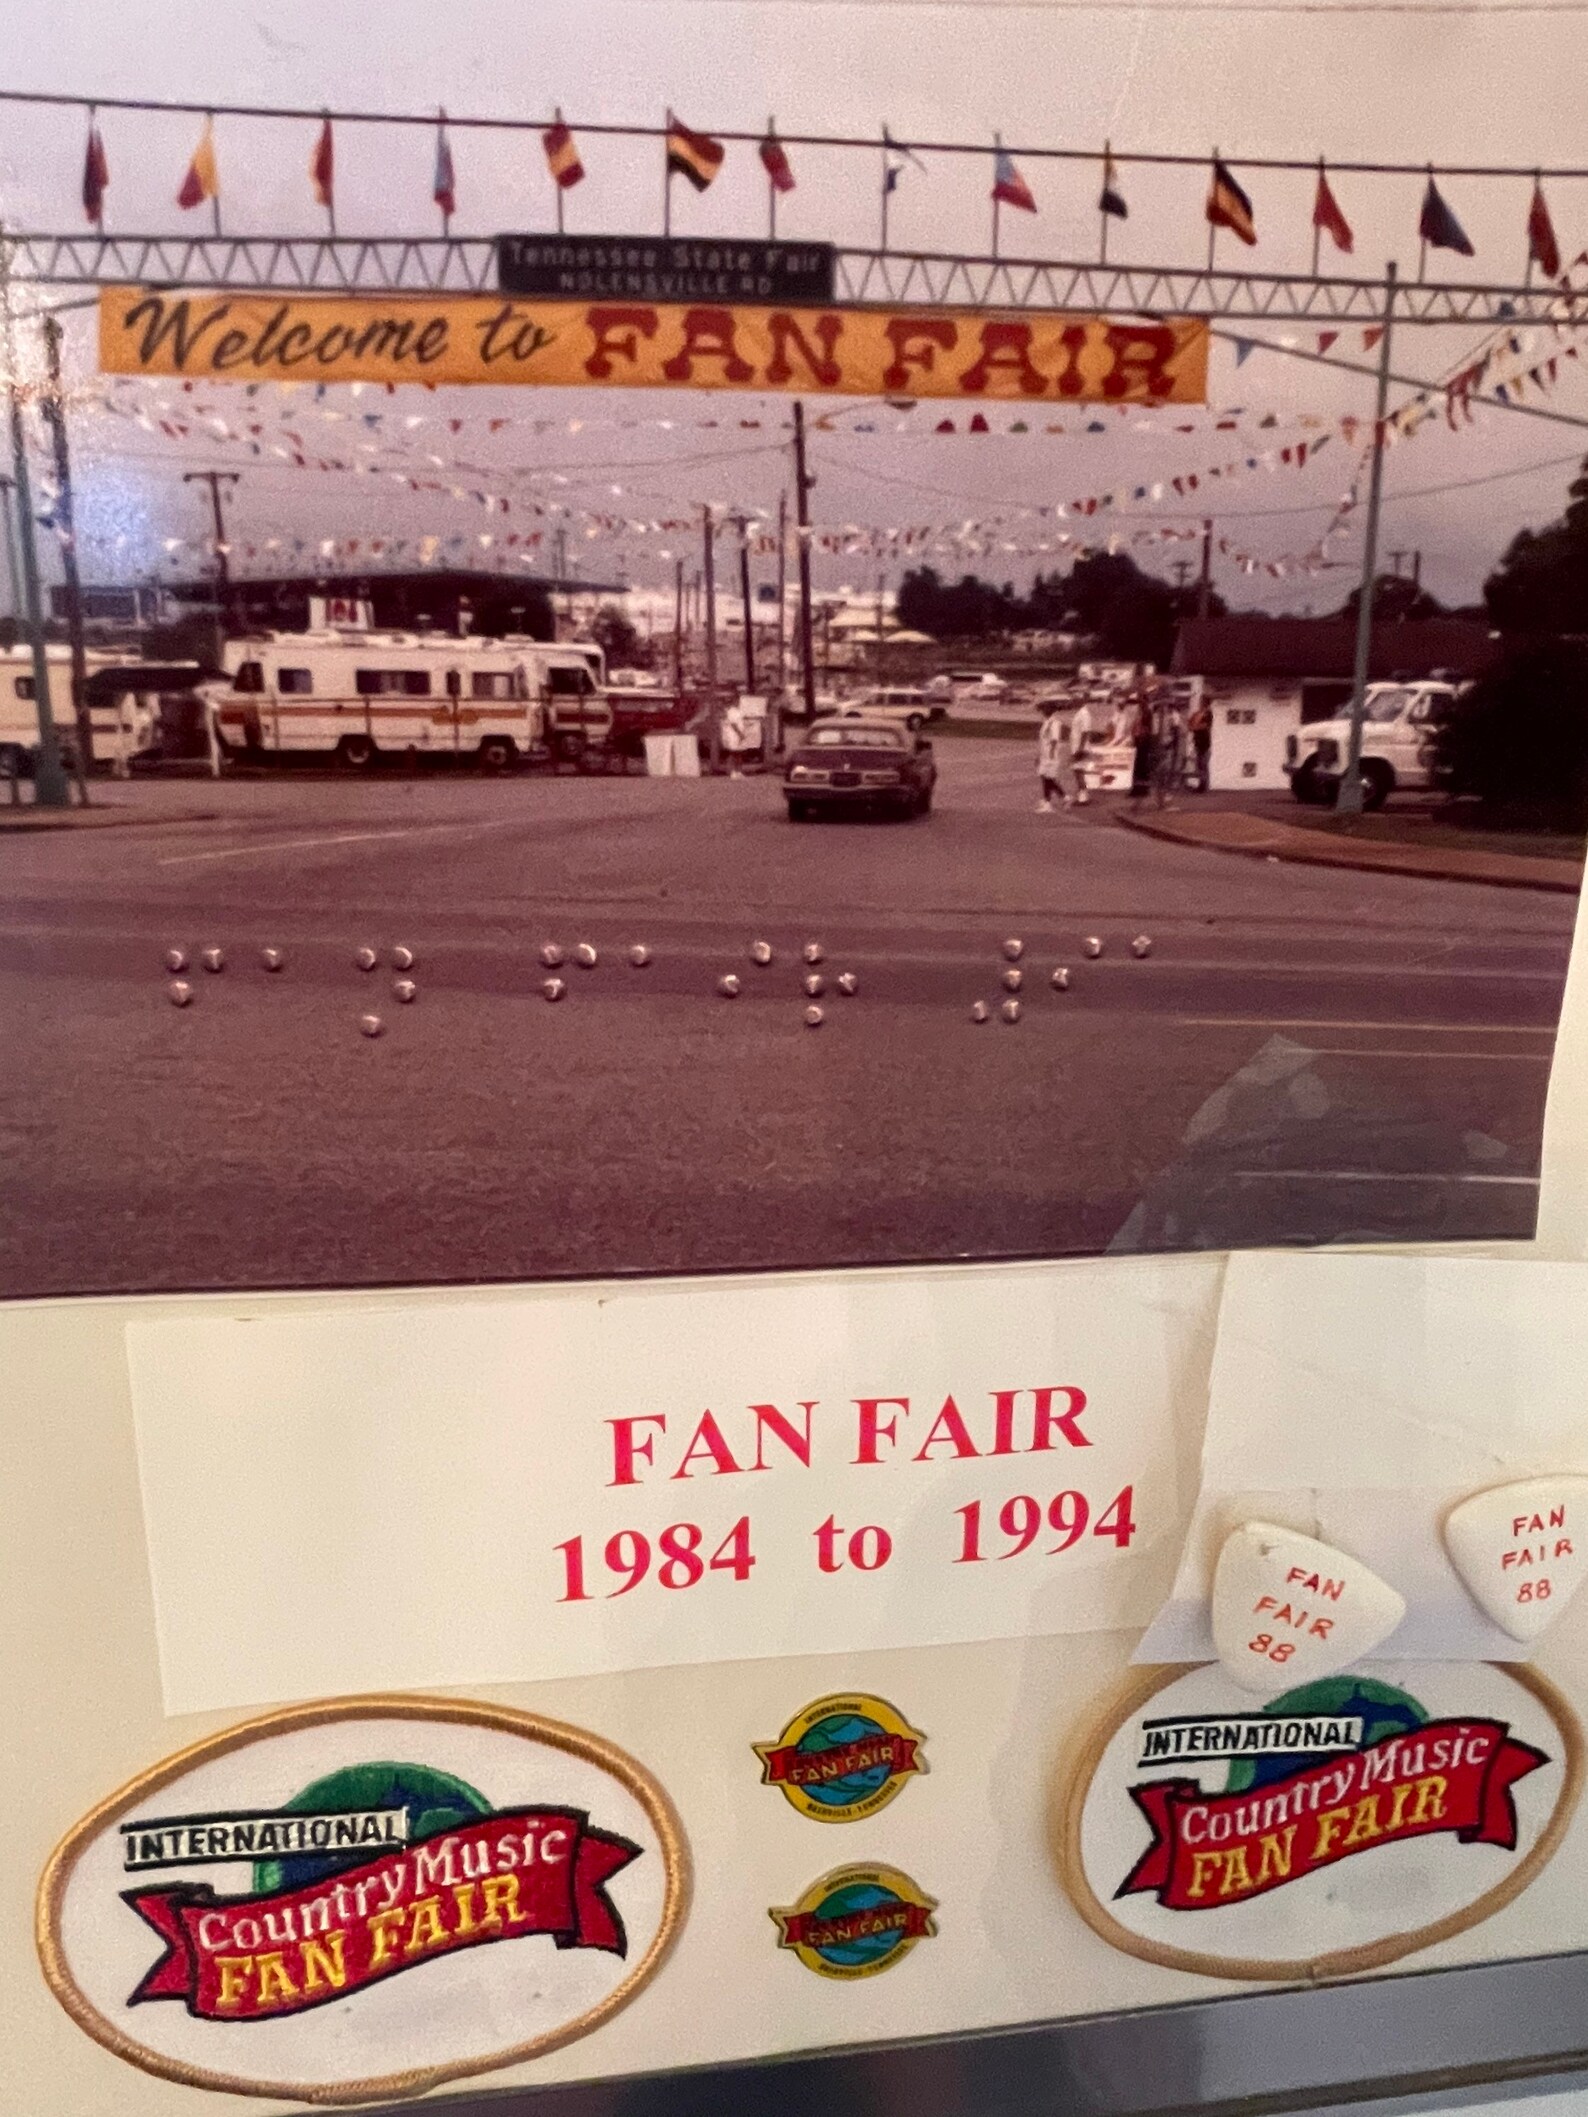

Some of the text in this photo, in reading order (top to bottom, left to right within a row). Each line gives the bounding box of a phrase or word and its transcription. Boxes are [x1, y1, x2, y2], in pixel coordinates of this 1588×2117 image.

[674, 245, 751, 271] State
[124, 299, 1177, 398] Welcome to FAN FAIR
[604, 1386, 1093, 1487] FAN FAIR
[1512, 1504, 1565, 1537] FAN
[552, 1485, 1135, 1602] 1984 to 1994
[1501, 1539, 1573, 1570] FAIR
[1286, 1567, 1346, 1601] FAN
[1516, 1578, 1552, 1604] 88
[1253, 1596, 1334, 1640] FAIR
[1248, 1633, 1295, 1663] 88
[1143, 1719, 1358, 1758] INTERNATIONAL
[791, 1747, 894, 1782] FAN FAIR
[1180, 1728, 1490, 1844] Country Music
[126, 1816, 404, 1863] INTERNATIONAL
[1186, 1776, 1449, 1898] FAN FAIR
[199, 1820, 568, 1953] Country Music
[214, 1874, 527, 2007] FAN FAIR
[807, 1914, 906, 1945] FAN FAIR
